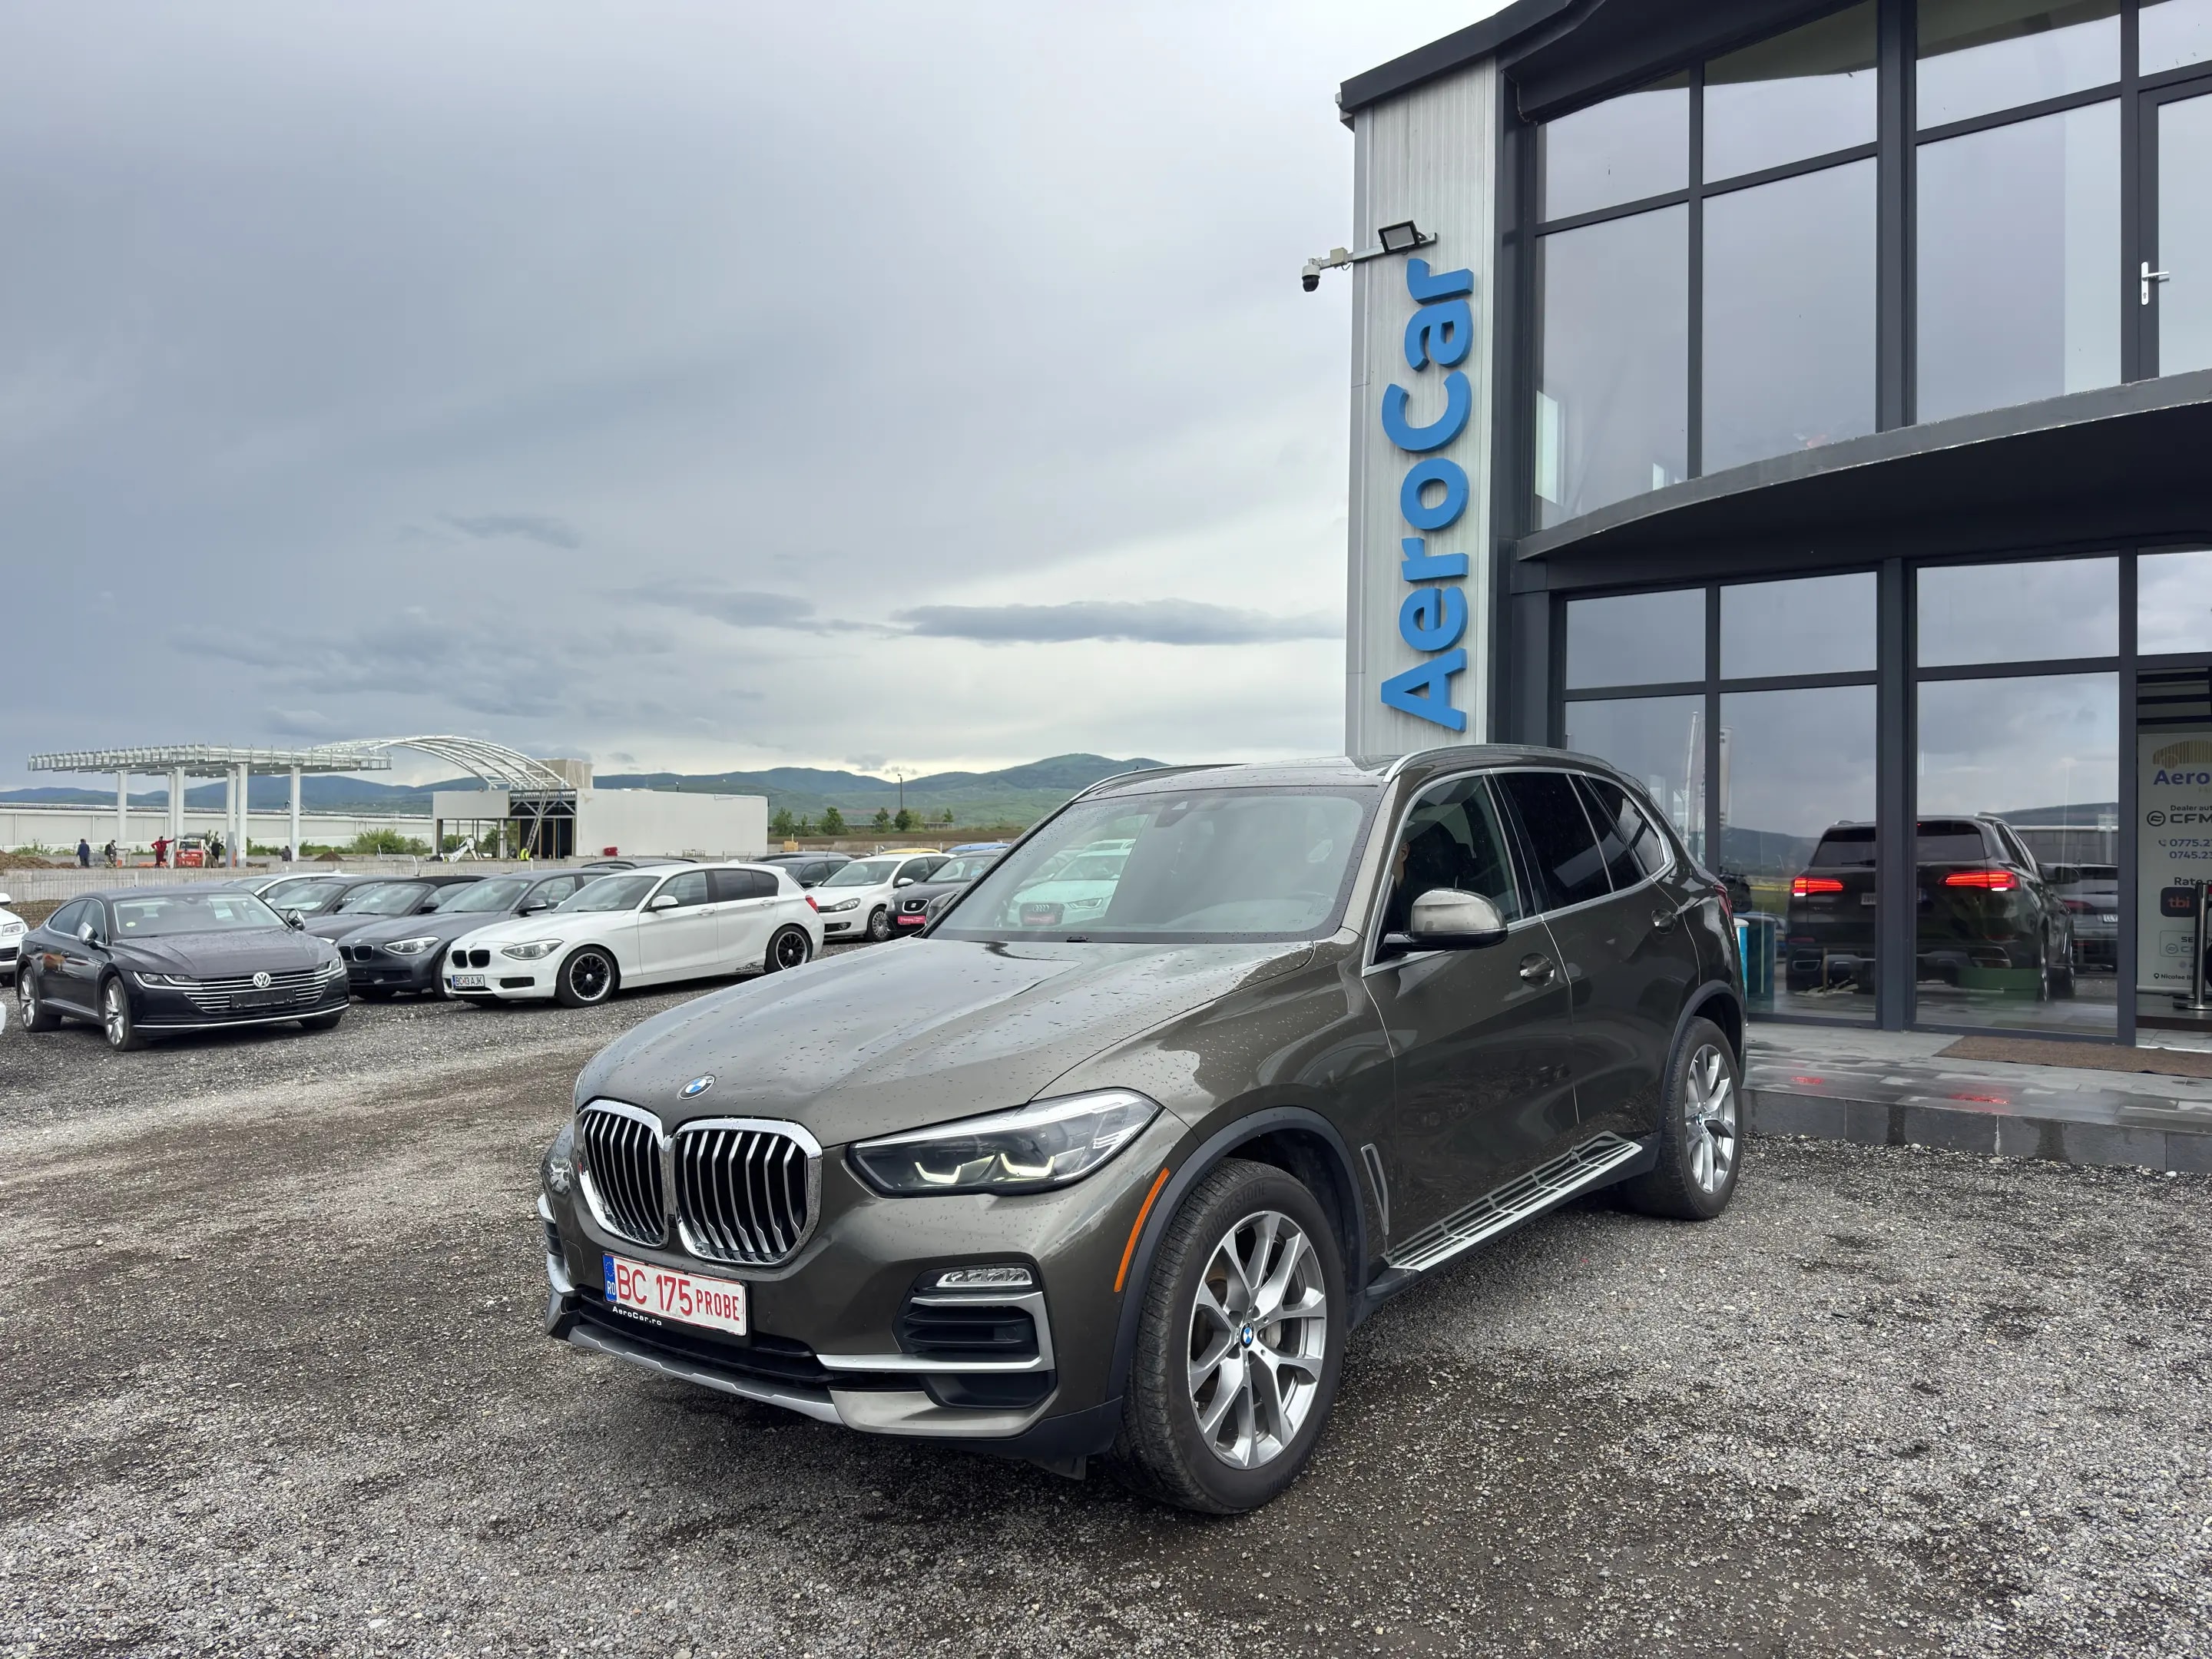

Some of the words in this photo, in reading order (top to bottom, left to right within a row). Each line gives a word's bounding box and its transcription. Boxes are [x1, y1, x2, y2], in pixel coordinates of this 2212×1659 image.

[1381, 258, 1474, 732] AeroCar
[607, 1280, 616, 1296] RO
[617, 1264, 647, 1304] BC
[656, 1274, 693, 1316] 175
[696, 1289, 740, 1321] PROBE
[612, 1306, 662, 1326] AeroCar.ro
